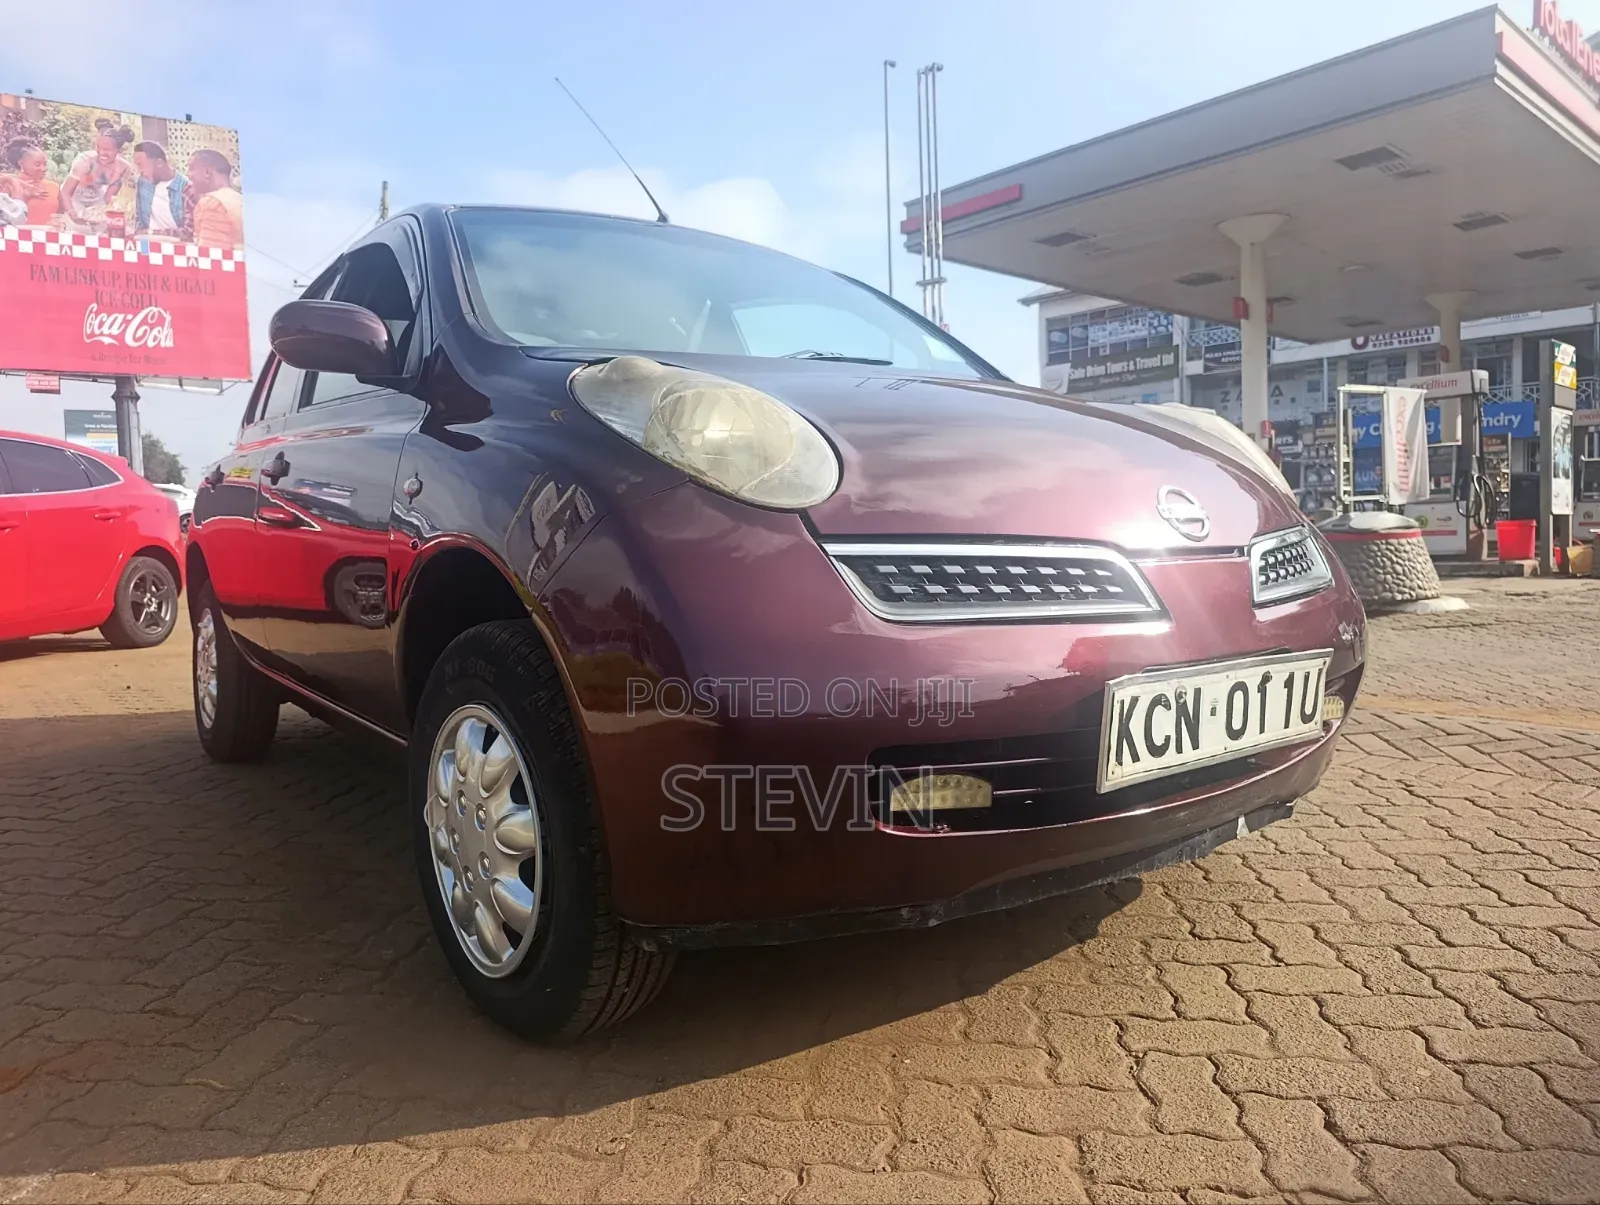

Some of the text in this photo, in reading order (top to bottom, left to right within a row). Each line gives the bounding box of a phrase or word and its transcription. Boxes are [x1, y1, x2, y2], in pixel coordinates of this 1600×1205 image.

[30, 264, 60, 283] FAM
[64, 267, 99, 286] LINK
[125, 272, 157, 291] FISH
[161, 276, 171, 292] &
[174, 277, 216, 296] UGALI
[95, 289, 158, 310] ICE COLD
[83, 302, 174, 348] Coca-Cola
[1135, 354, 1161, 370] Travel
[1115, 667, 1324, 766] KCN 011U
